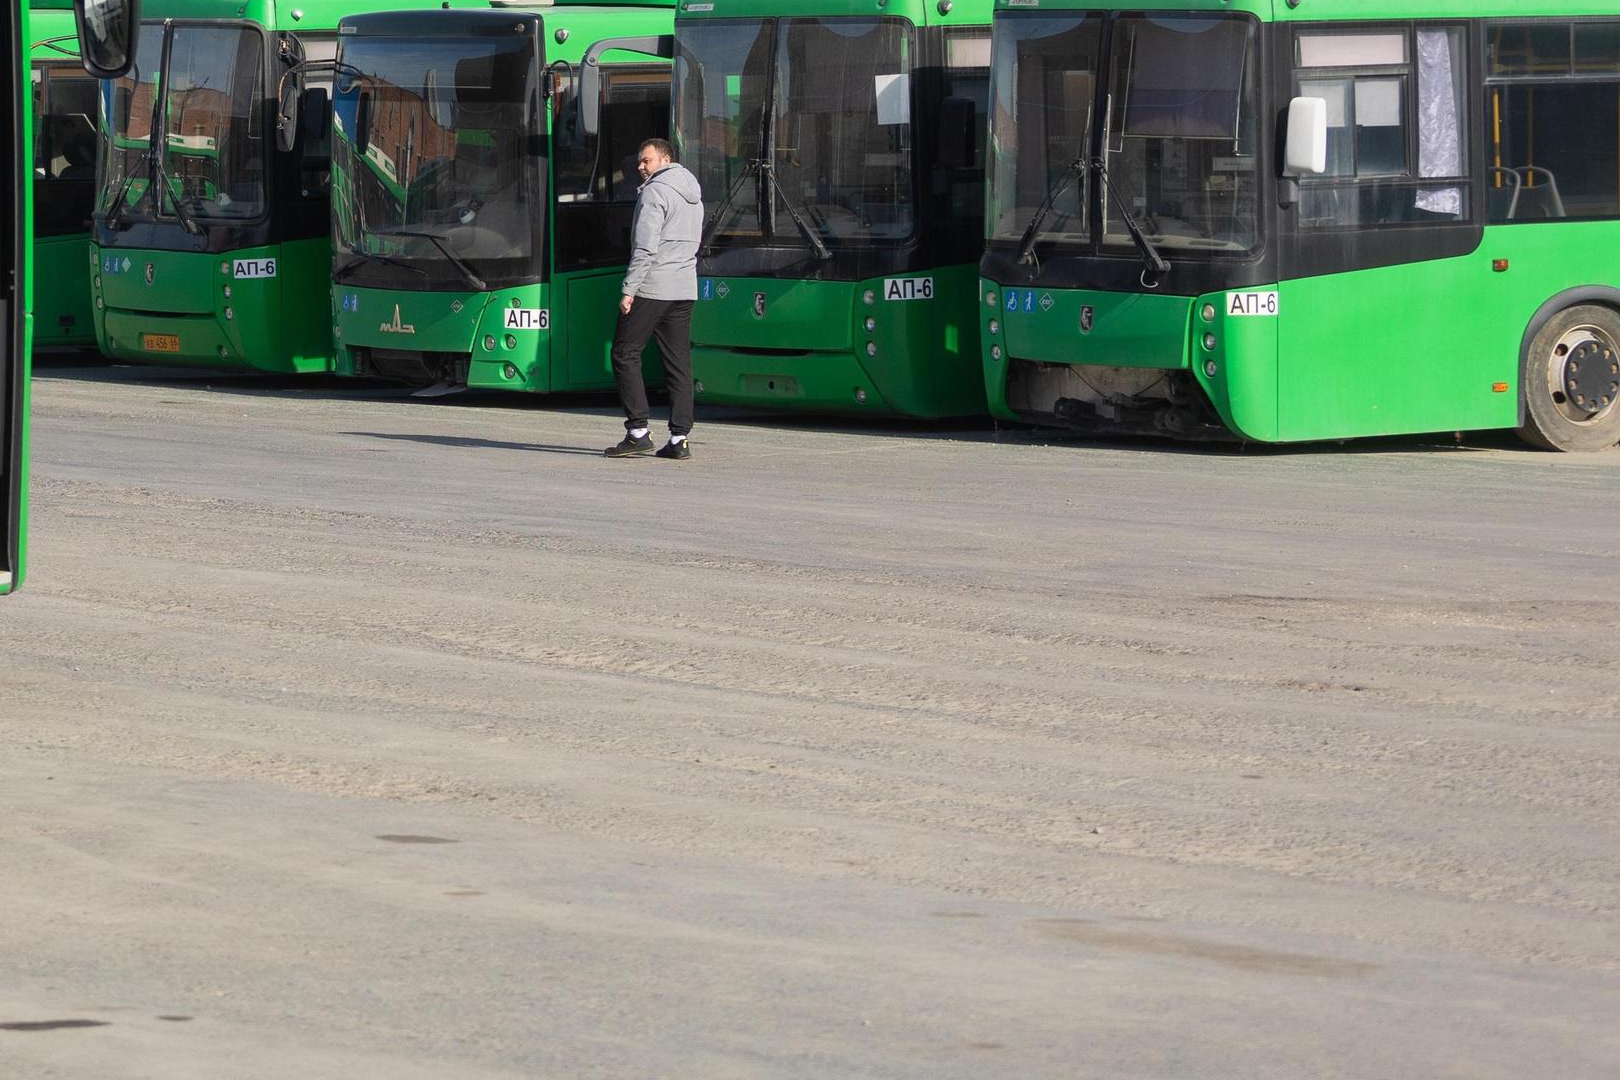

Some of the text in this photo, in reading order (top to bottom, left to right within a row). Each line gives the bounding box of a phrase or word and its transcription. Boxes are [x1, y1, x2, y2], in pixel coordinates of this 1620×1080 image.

[234, 260, 275, 276] АП-6
[887, 278, 932, 299] АП-6
[1230, 293, 1276, 314] АП-6
[506, 309, 548, 328] АП-6
